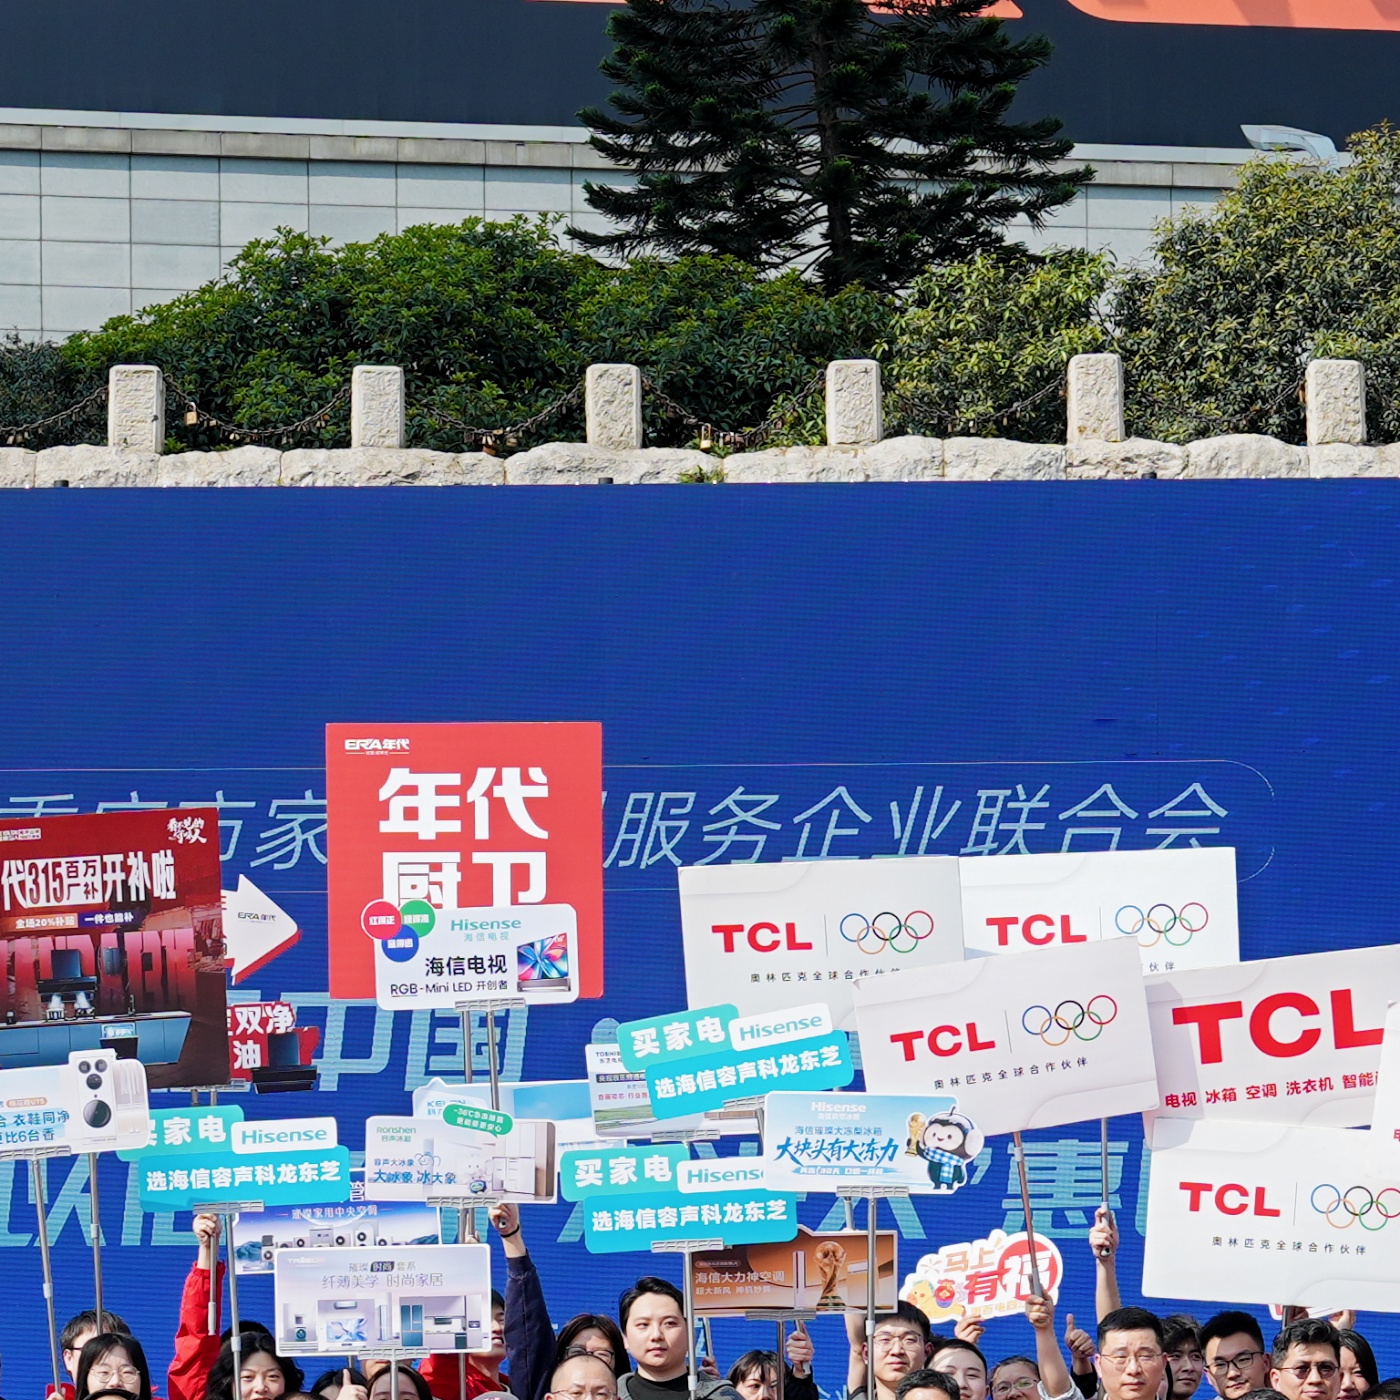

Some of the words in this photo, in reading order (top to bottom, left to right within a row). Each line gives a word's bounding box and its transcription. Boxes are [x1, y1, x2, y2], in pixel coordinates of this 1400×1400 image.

[344, 738, 410, 751] ERA年代
[378, 766, 549, 840] 年代
[66, 858, 100, 880] 百万
[101, 848, 177, 903] 开补啦
[382, 851, 548, 909] 厨卫
[450, 917, 522, 932] Hisense
[464, 932, 510, 942] 海信电视
[712, 921, 813, 954] TCL
[986, 913, 1087, 946] TCL
[424, 954, 509, 977] 海信电视
[452, 982, 473, 993] LED
[476, 979, 509, 991] 开创者
[630, 1016, 726, 1058] 买家电
[738, 1012, 823, 1042] Hisense
[1172, 988, 1385, 1065] TCL
[890, 1023, 996, 1063] TCL
[654, 1044, 842, 1100] 选海信容声科龙东芝
[933, 1056, 1089, 1091] 奥林匹克全球合作伙伴
[811, 1101, 867, 1113] Hisense
[1164, 1091, 1198, 1109] 电视
[1205, 1087, 1238, 1104] 冰箱
[1245, 1083, 1278, 1099] 空调
[1285, 1075, 1335, 1096] 洗衣机
[13, 1110, 71, 1127] 衣鞋同净
[240, 1126, 328, 1145] Hisense
[775, 1137, 900, 1167] 大块头有大冻力
[146, 1160, 342, 1192] 选海信容声科龙东芝
[574, 1153, 673, 1188] 买家电
[1179, 1181, 1281, 1218] TCL
[592, 1199, 788, 1233] 选海信容声科龙东芝
[943, 1248, 996, 1273] 马上
[1212, 1235, 1368, 1256] 奥林匹克全球合作伙伴
[322, 1274, 380, 1290] 纤薄美学
[386, 1272, 444, 1288] 时尚家居
[695, 1270, 786, 1284] 海信大力神空调
